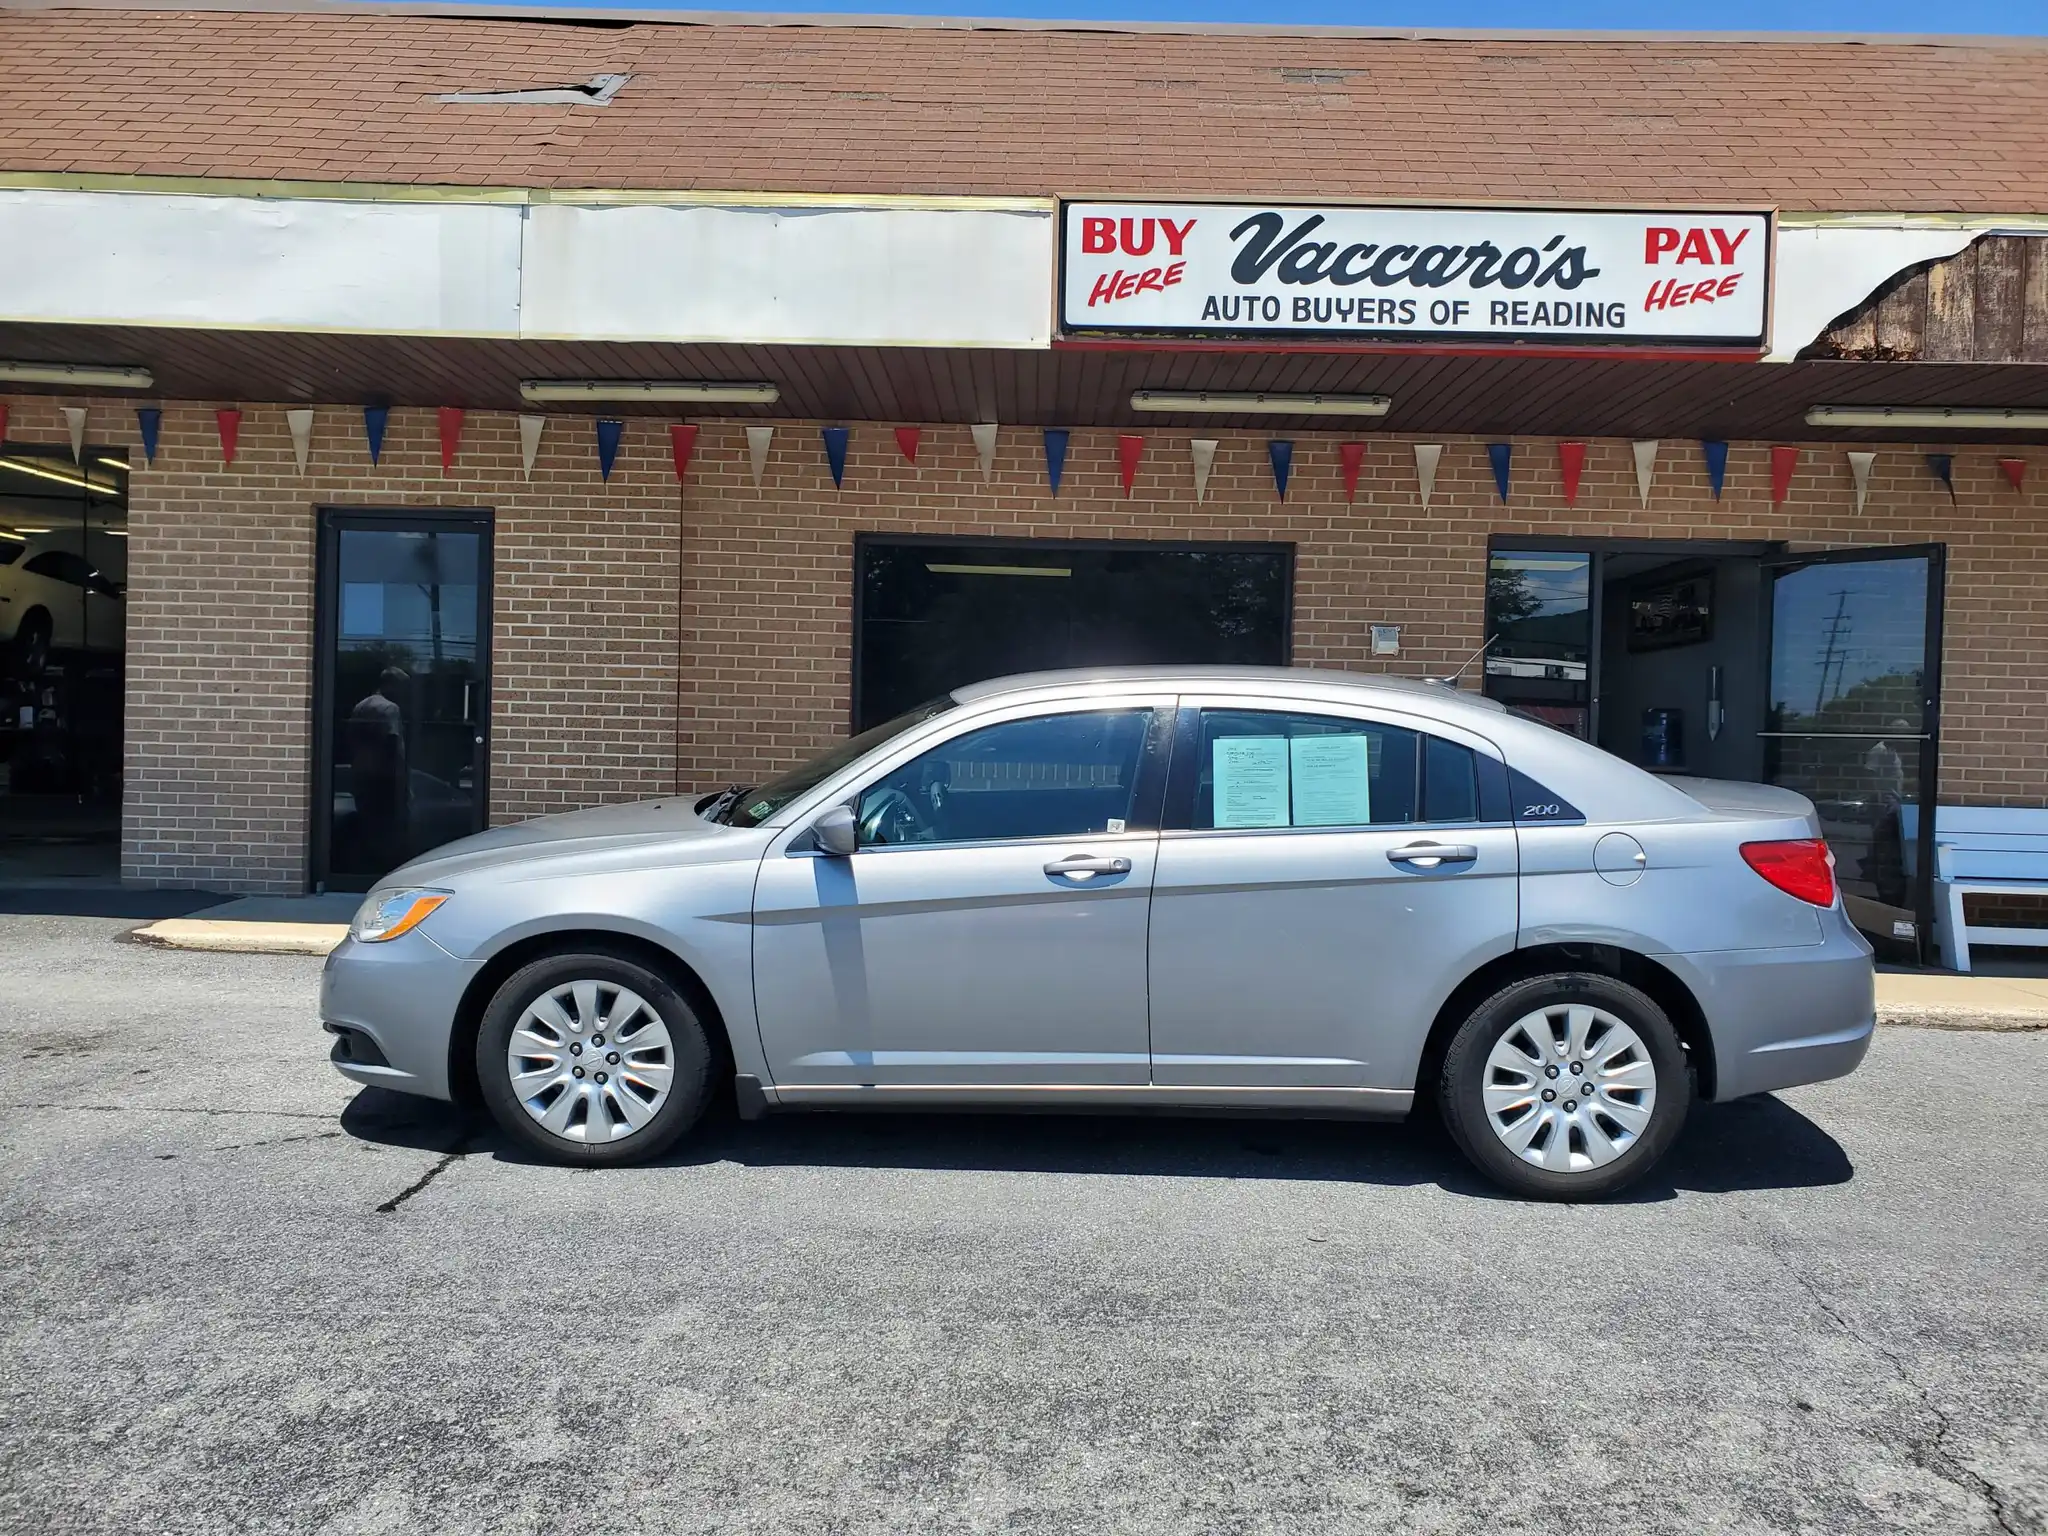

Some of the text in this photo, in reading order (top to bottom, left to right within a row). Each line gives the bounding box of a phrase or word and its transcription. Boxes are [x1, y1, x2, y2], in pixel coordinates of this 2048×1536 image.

[1081, 217, 1197, 256] BUY
[1229, 211, 1601, 291] Vaccaro's
[1644, 227, 1751, 265] PAY
[1087, 260, 1187, 308] HERE
[1644, 272, 1744, 313] HERE
[1201, 295, 1625, 329] AUTO BUYERS OF READING
[1523, 804, 1560, 816] 200
